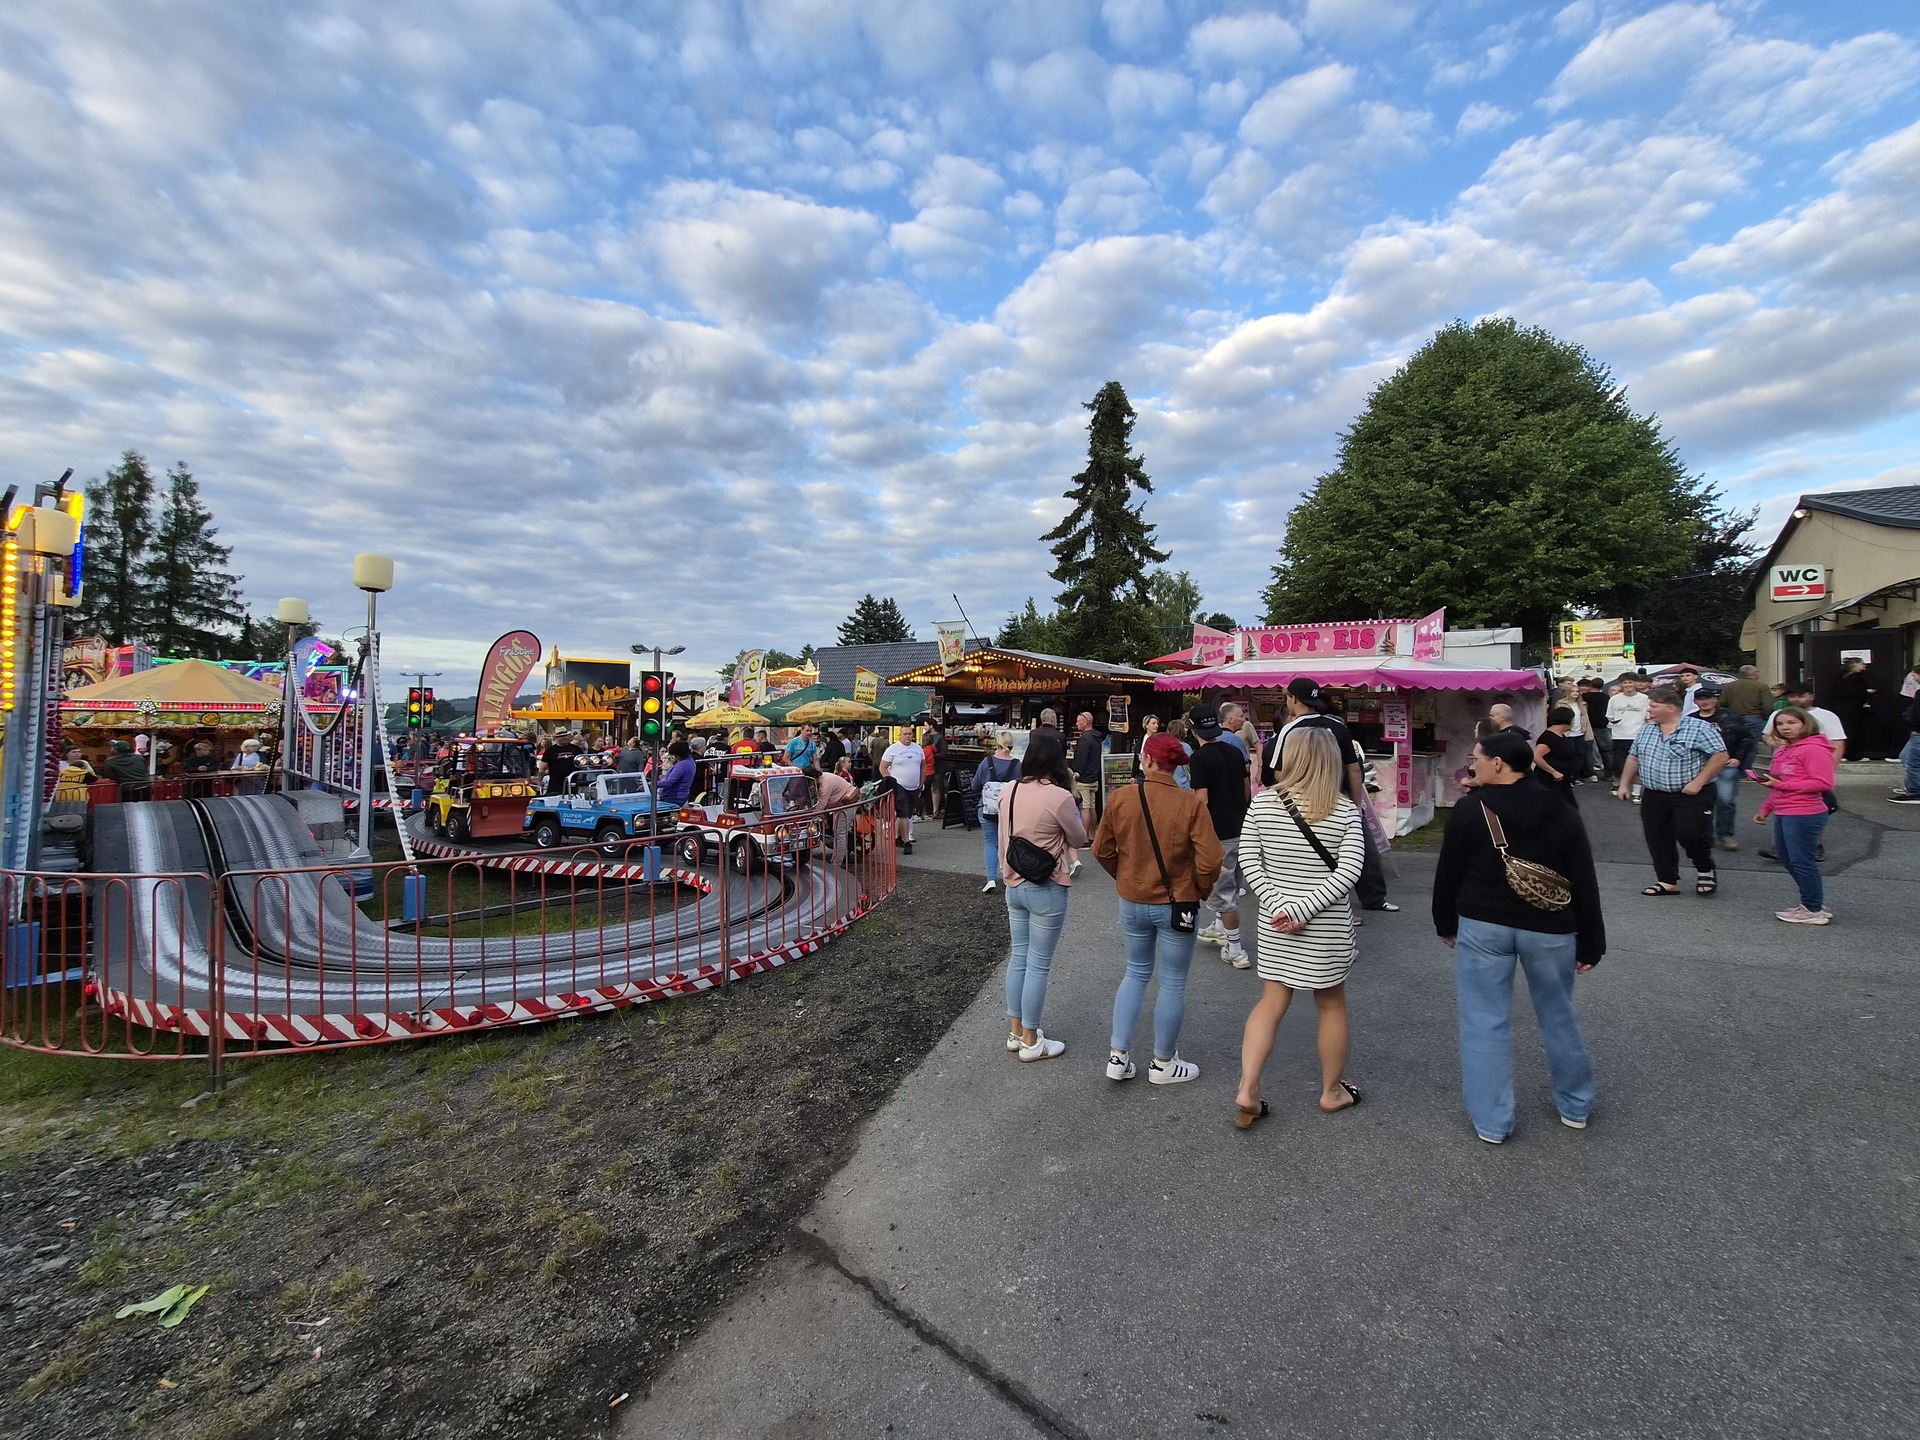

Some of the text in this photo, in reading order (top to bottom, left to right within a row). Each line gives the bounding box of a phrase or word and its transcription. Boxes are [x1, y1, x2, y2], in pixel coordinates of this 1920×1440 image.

[1778, 568, 1819, 583] WC
[1194, 635, 1226, 646] SOFT
[1260, 628, 1376, 654] SOFT EIS
[499, 645, 535, 656] Frische
[1203, 648, 1226, 661] EIS
[1398, 755, 1410, 803] EIS
